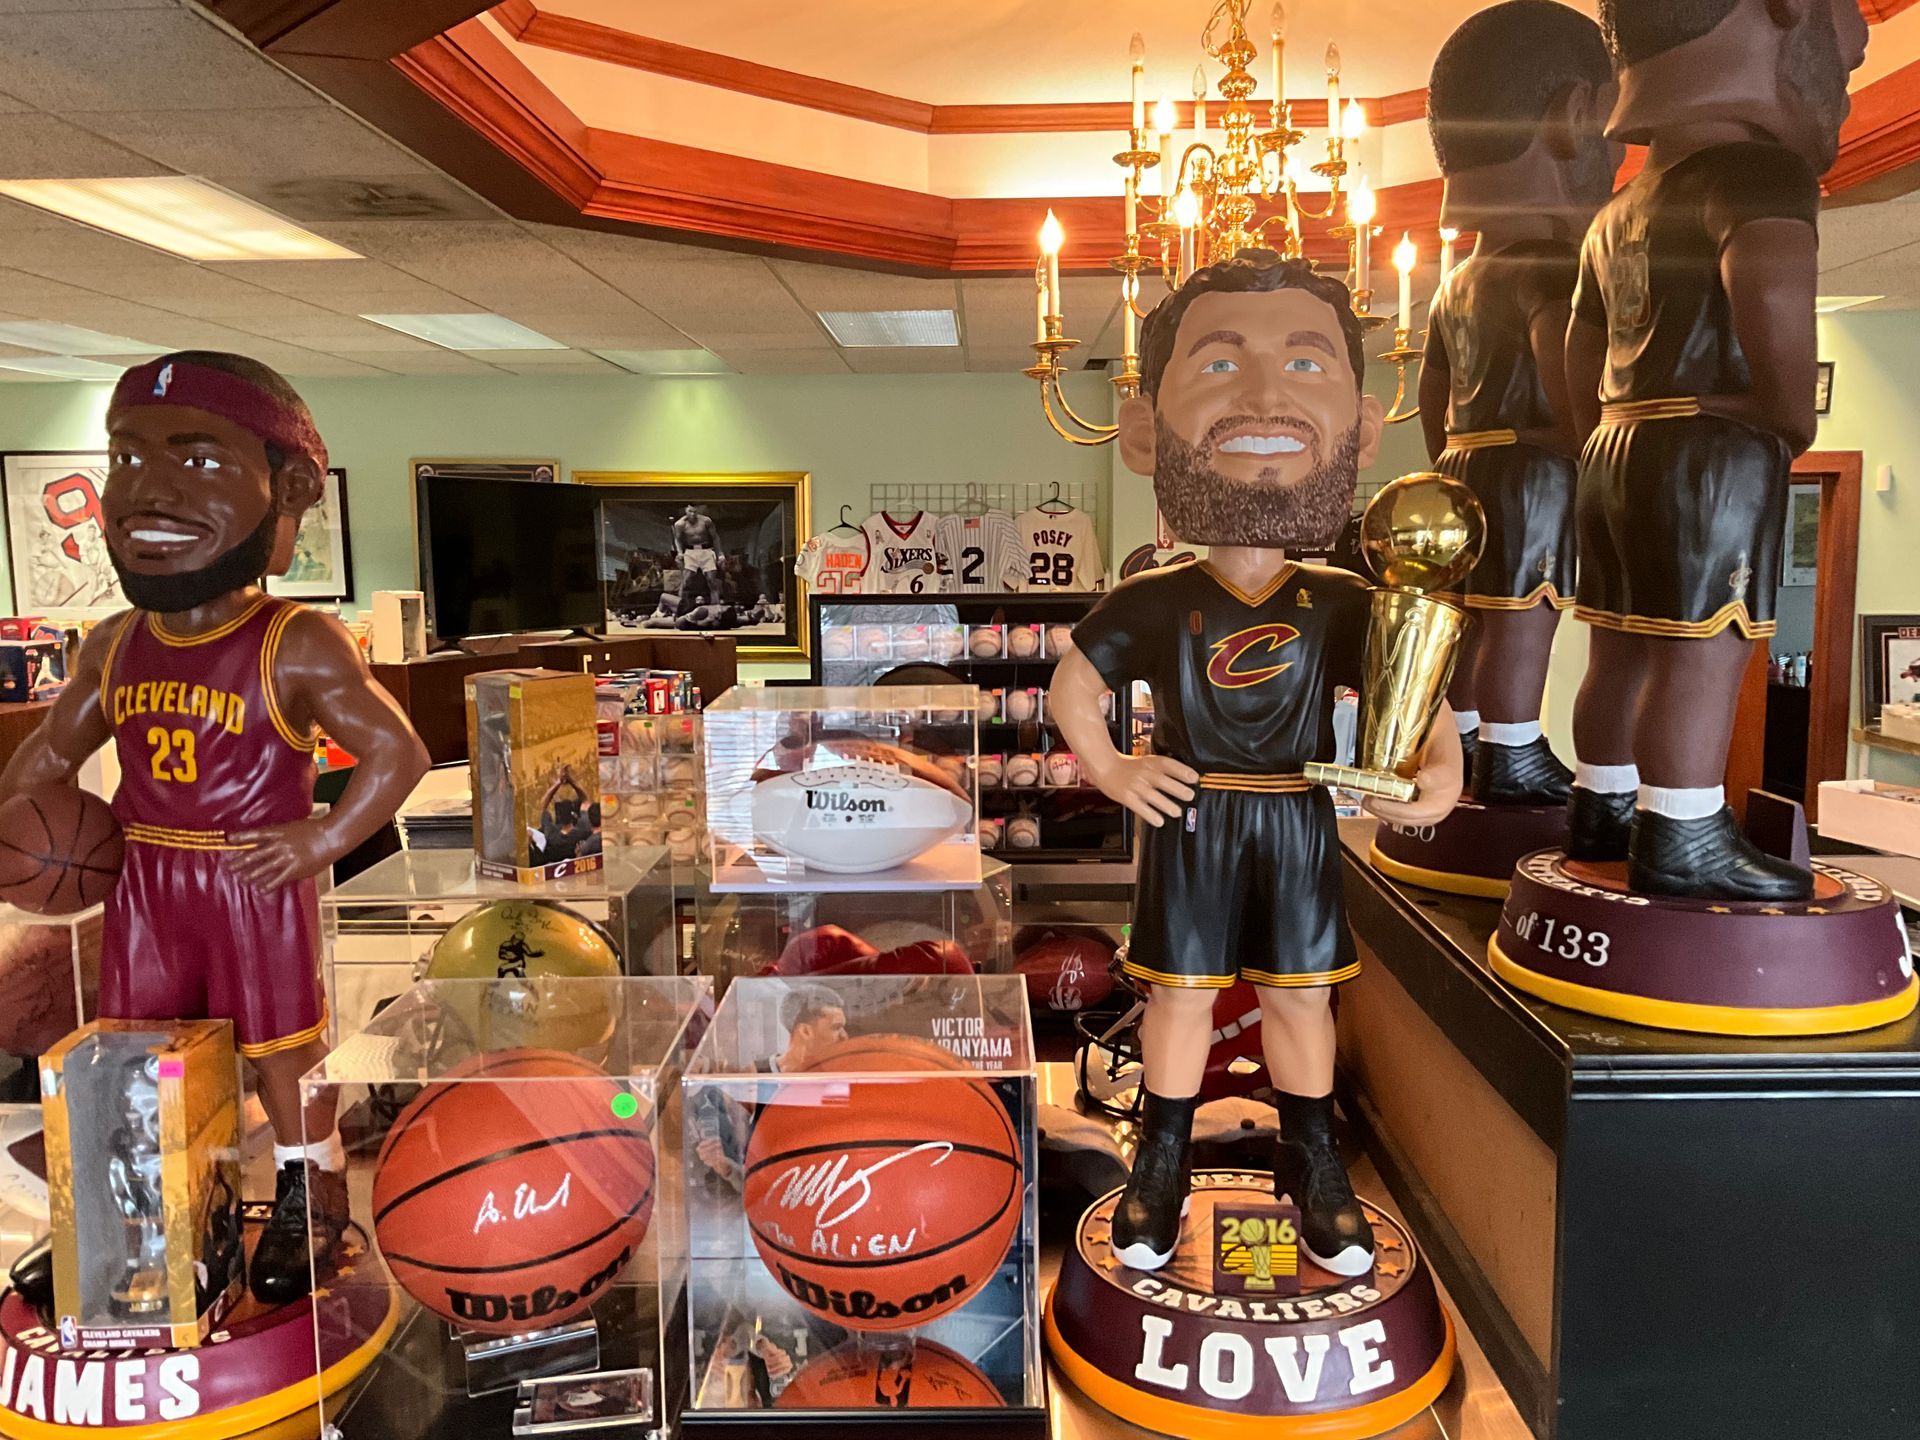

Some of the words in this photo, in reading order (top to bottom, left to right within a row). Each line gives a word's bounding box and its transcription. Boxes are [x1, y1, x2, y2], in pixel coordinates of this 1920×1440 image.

[1033, 530, 1073, 548] POSEY
[826, 553, 862, 568] HADEN
[962, 547, 984, 584] 2
[1029, 552, 1074, 586] 28
[910, 574, 924, 594] 6
[114, 680, 246, 736] CLEVELAND
[147, 726, 198, 783] 23
[806, 790, 886, 812] Wilson
[574, 858, 597, 874] 2016
[1515, 912, 1538, 941] of
[1537, 918, 1610, 967] 133
[931, 1017, 984, 1037] VICTOR
[986, 1060, 1003, 1070] YEAR
[444, 1244, 630, 1322] Wilson
[776, 1260, 970, 1319] Wilson
[1132, 1278, 1382, 1322] CAVALIERS
[82, 1328, 121, 1338] CLEVELAND
[122, 1328, 161, 1338] CAVALIERS
[1134, 1314, 1396, 1403] LOVE
